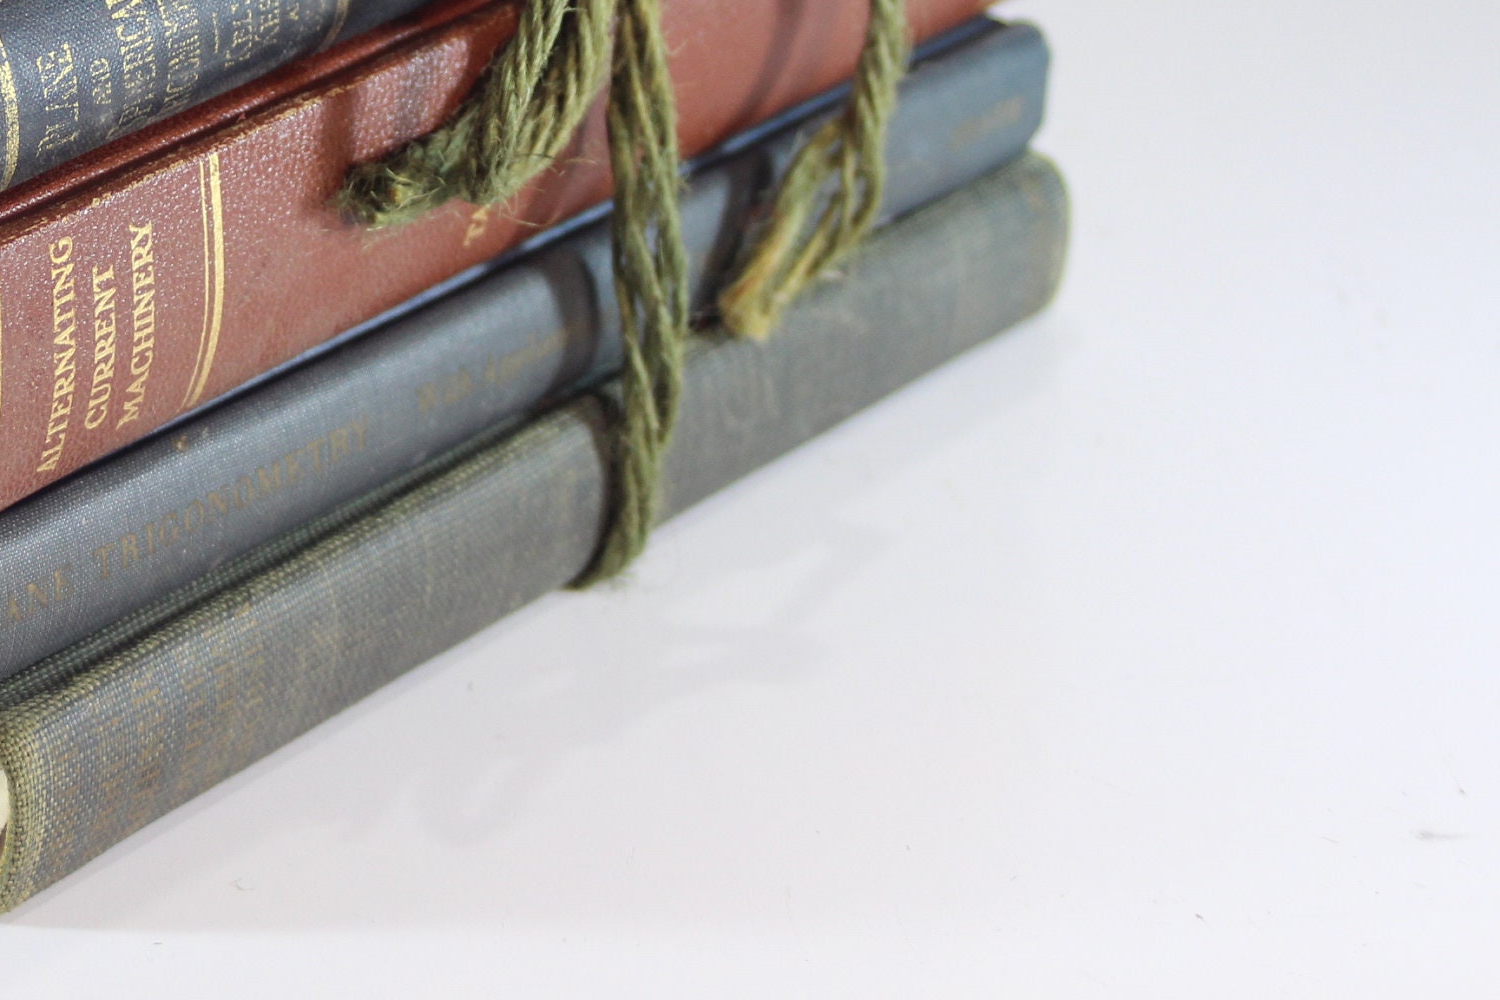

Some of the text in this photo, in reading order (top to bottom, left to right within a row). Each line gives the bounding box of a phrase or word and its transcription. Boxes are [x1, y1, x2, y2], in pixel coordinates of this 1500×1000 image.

[35, 234, 77, 475] ALTERNATING
[83, 264, 117, 430] CURRENT
[115, 220, 156, 431] MACHINERY
[92, 414, 374, 580] TRIGONOMETRY
